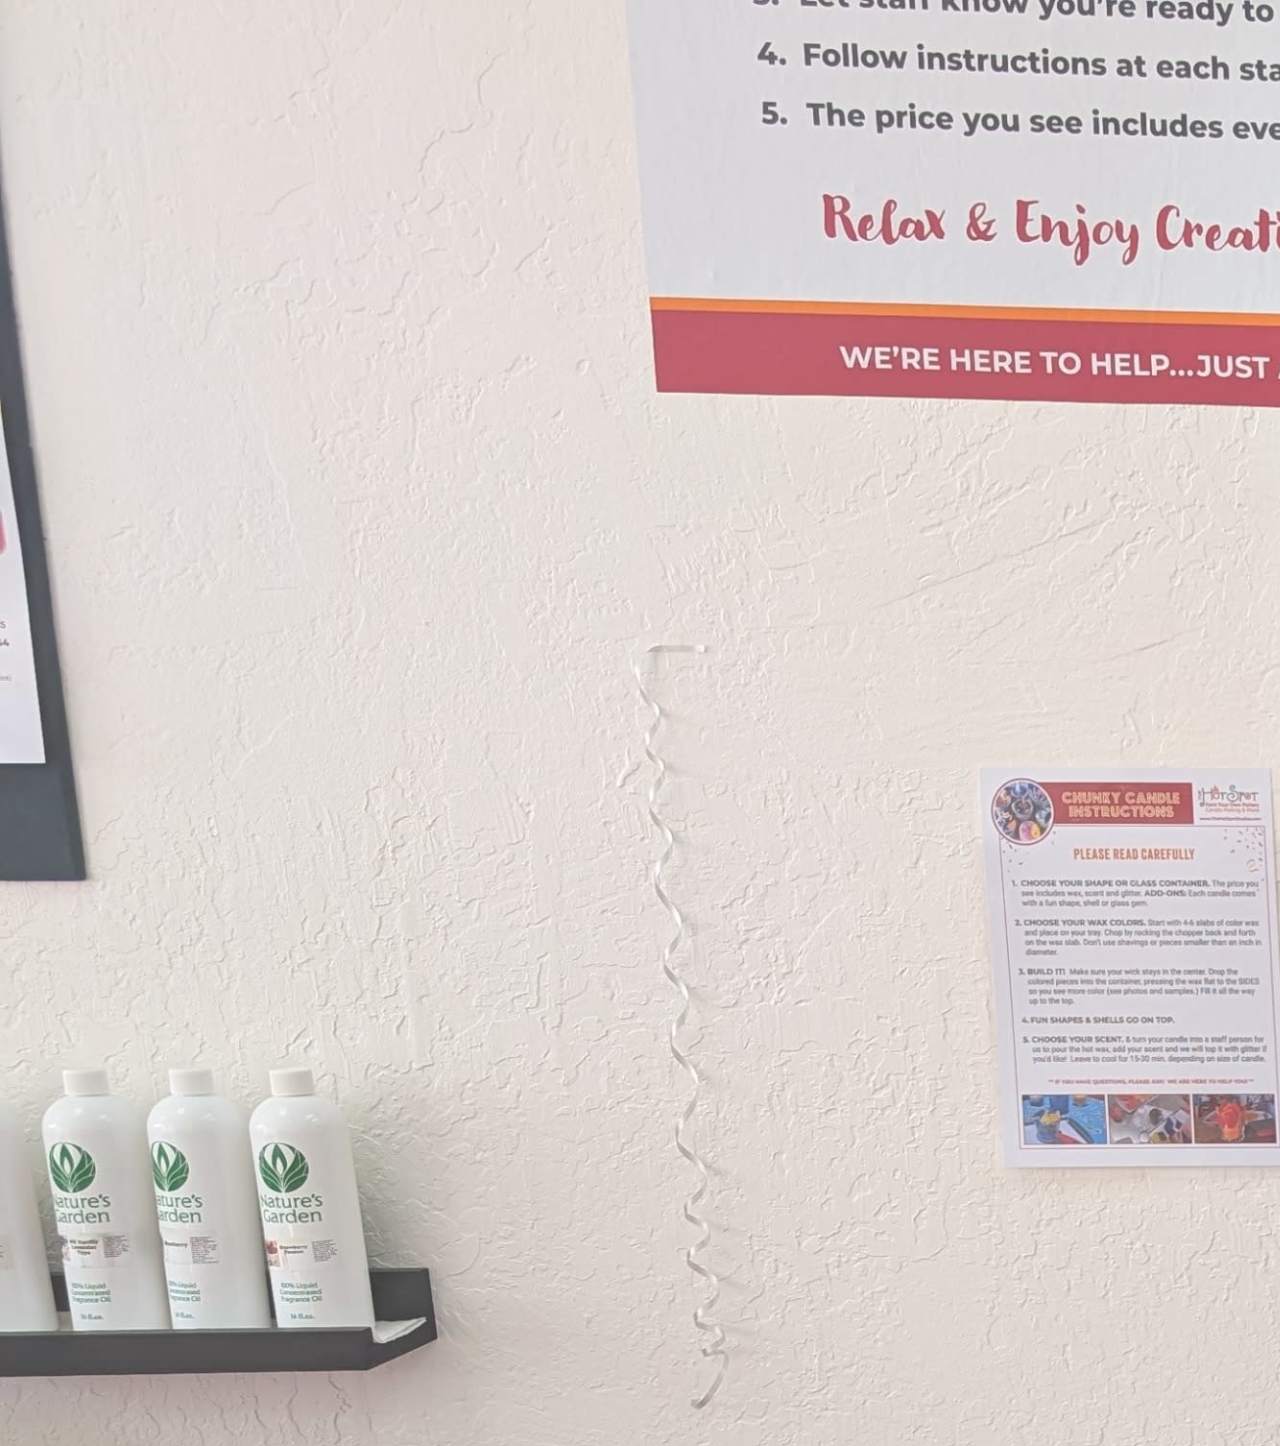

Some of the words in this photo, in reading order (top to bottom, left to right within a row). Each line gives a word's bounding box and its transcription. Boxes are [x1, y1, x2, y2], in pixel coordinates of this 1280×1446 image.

[1038, 0, 1136, 21] you're
[1146, 0, 1234, 27] ready
[1242, 0, 1274, 23] to
[757, 41, 787, 66] 4.
[803, 42, 908, 69] Follow
[916, 43, 1107, 76] instructions
[1116, 55, 1147, 78] at
[1156, 55, 1230, 80] each
[762, 101, 788, 125] 5.
[805, 102, 866, 127] The
[875, 103, 954, 134] price
[962, 112, 1020, 137] you
[1029, 114, 1083, 134] see
[1092, 108, 1224, 139] includes
[822, 194, 946, 245] Relax
[966, 202, 997, 242] &
[1016, 199, 1139, 266] Enjoy
[839, 346, 941, 370] WE'RE
[950, 349, 1032, 373] HERE
[1039, 351, 1081, 375] TO
[1061, 792, 1122, 805] CHUNKY
[1123, 792, 1181, 805] CANDLE
[1069, 805, 1175, 818] INSTRUCTIONS
[1073, 848, 1111, 860] PLEASE
[1113, 848, 1139, 860] READ
[1140, 848, 1195, 860] CAREFULLY
[56, 1193, 111, 1209] ature's
[262, 1209, 323, 1224] Garden
